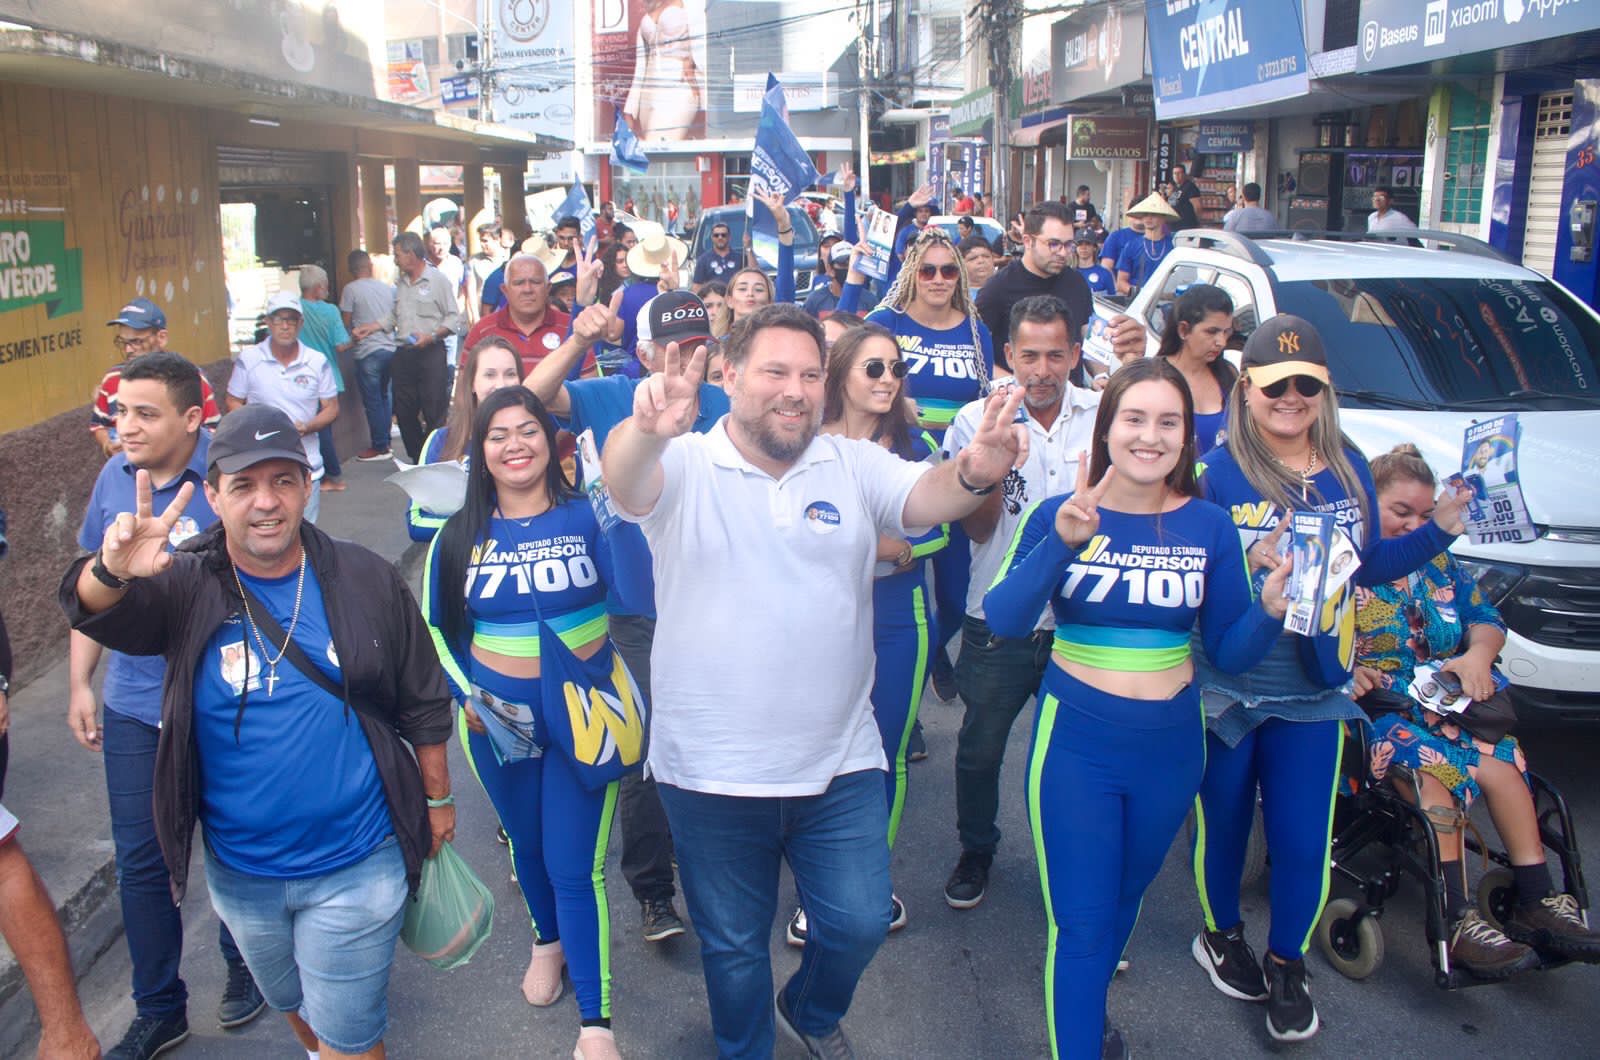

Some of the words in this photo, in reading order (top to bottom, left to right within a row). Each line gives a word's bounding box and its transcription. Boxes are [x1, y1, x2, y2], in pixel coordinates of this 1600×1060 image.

[1380, 23, 1418, 48] Baseus
[1527, 0, 1580, 18] App
[1180, 7, 1249, 71] CENTRAL
[516, 48, 565, 57] REVENDEDOA
[1073, 147, 1142, 158] ADVOGADOS
[1207, 137, 1242, 147] CENTRAL
[0, 231, 31, 266] RO
[0, 264, 57, 299] VERDE
[662, 307, 704, 323] BOZO
[58, 325, 82, 350] CAFÉ
[1277, 331, 1300, 354] NY
[902, 352, 978, 380] 7100
[518, 538, 552, 550] DEPUTADO
[554, 535, 585, 546] ESTADUAL
[1478, 529, 1522, 544] 77100
[1131, 544, 1170, 555] DEPUTADO
[1172, 547, 1208, 557] ESTADUAL
[1060, 563, 1205, 608] 77100
